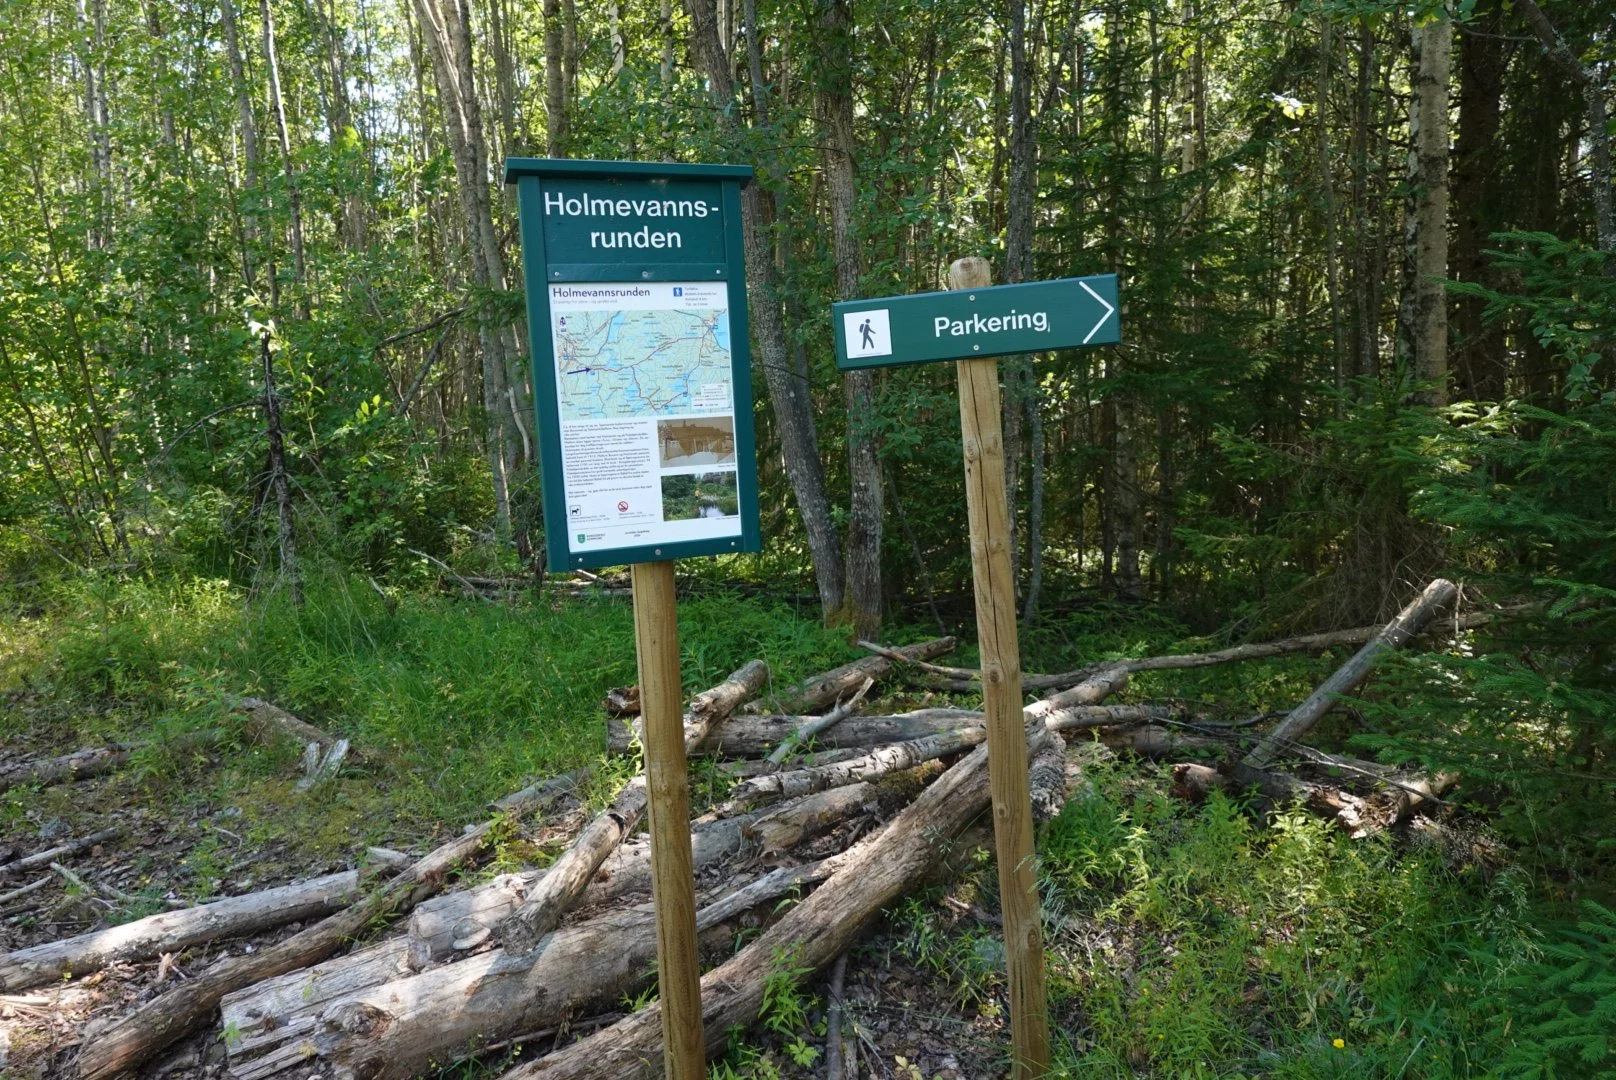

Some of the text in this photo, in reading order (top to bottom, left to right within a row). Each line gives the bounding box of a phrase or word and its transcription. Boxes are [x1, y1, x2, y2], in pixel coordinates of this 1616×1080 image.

[544, 192, 719, 218] Holmevanns-
[590, 226, 681, 248] runden
[553, 287, 650, 298] Holmevannsrunden
[934, 309, 1050, 337] Parkering
